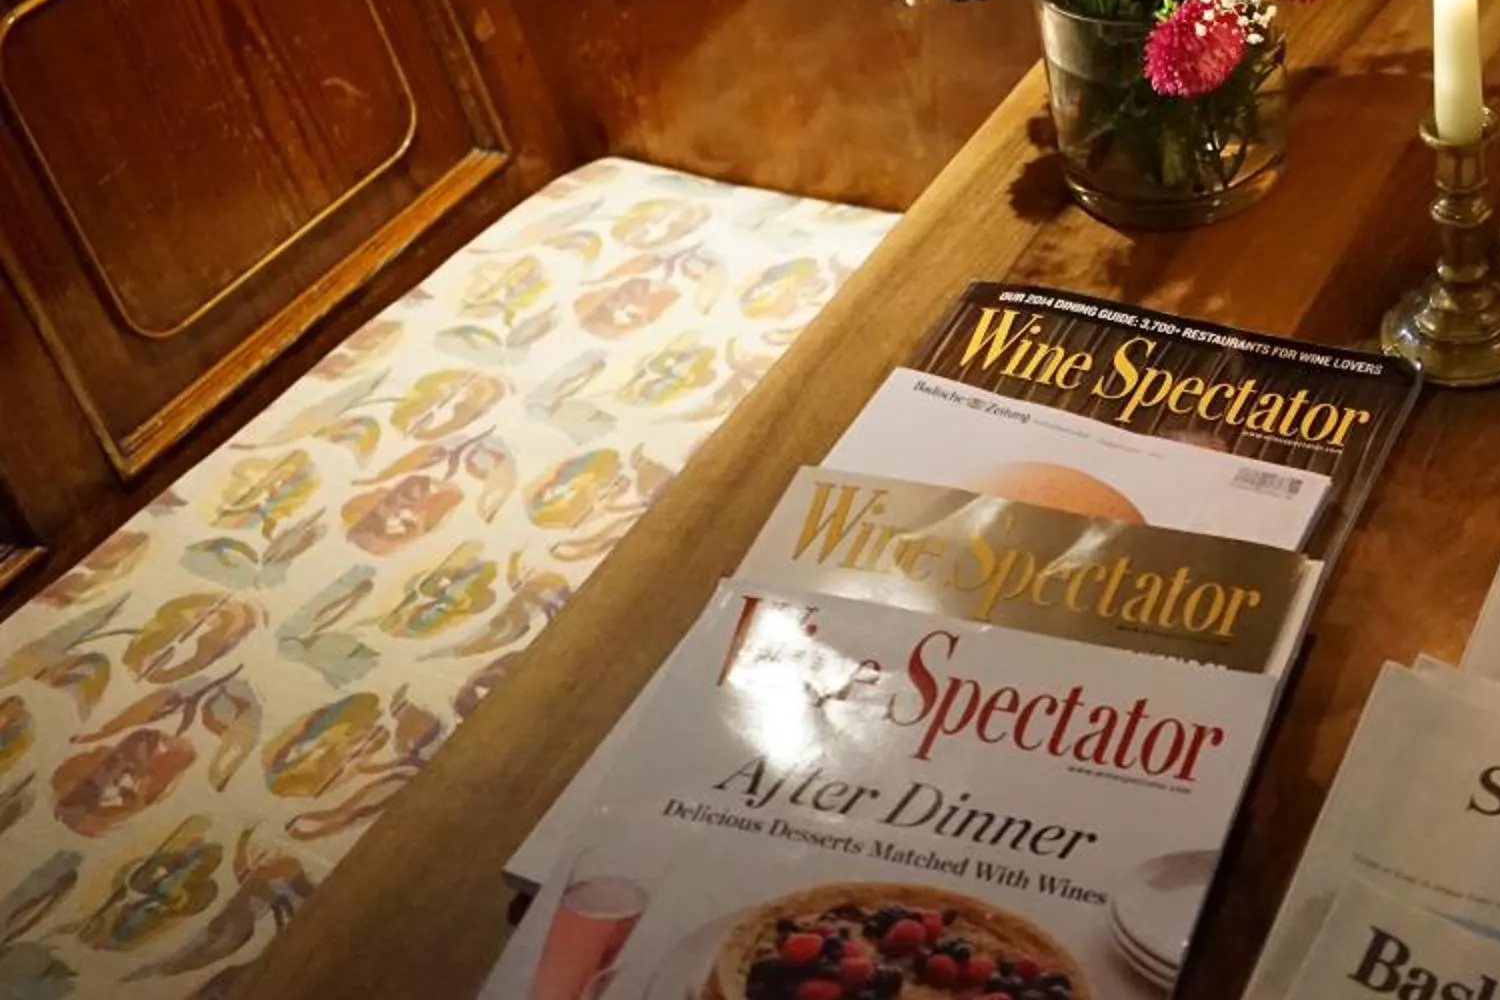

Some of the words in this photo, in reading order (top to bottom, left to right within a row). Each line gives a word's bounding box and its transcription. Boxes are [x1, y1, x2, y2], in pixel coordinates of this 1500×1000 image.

[959, 307, 1093, 389] Wine
[1091, 336, 1371, 447] Spectator
[999, 291, 1025, 302] OUR
[1025, 294, 1054, 308] 2014
[1054, 299, 1098, 317] DINING
[1098, 307, 1139, 327] GUIDE:
[1182, 326, 1271, 355] RESTAURANTS
[1271, 346, 1298, 361] FOR
[1299, 351, 1331, 366] WINE
[1333, 358, 1384, 375] LOVERS
[792, 481, 946, 582] Wine
[944, 510, 1262, 638] Spectator
[883, 630, 1225, 782] Spectator
[663, 798, 763, 834] Delicious
[768, 818, 863, 855] Desserts
[868, 840, 969, 876] Matched
[974, 860, 1031, 890] With
[1038, 873, 1109, 905] Wines
[713, 755, 880, 816] After
[878, 781, 1098, 860] Dinner
